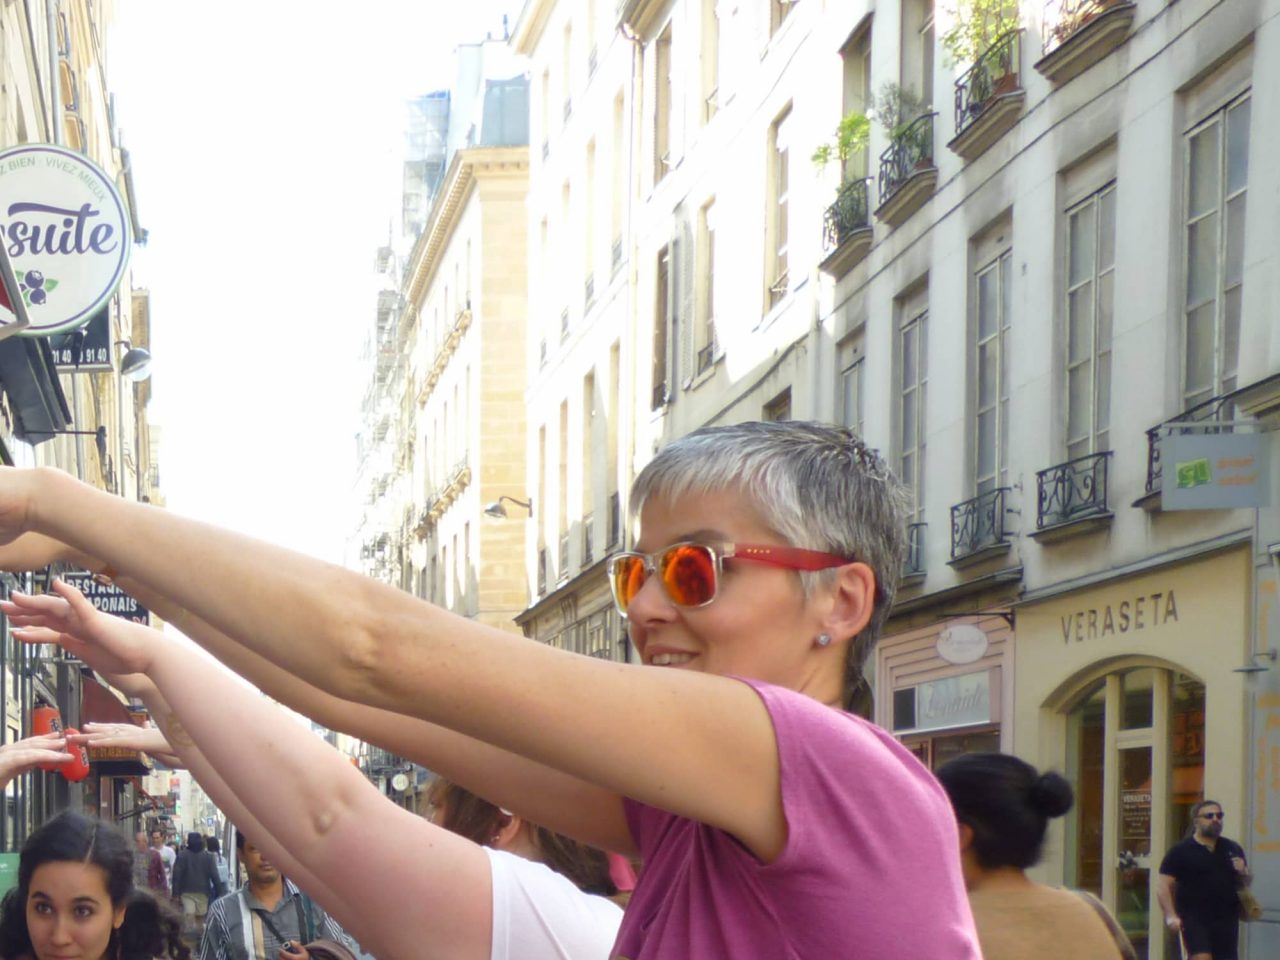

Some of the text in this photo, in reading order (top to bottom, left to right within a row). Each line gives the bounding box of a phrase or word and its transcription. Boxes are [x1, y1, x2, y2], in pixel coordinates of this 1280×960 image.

[8, 156, 37, 173] BIEN
[45, 156, 78, 177] VIVEZ
[77, 171, 108, 203] MIEUX
[0, 202, 119, 258] suite
[1060, 589, 1179, 645] VERASETA
